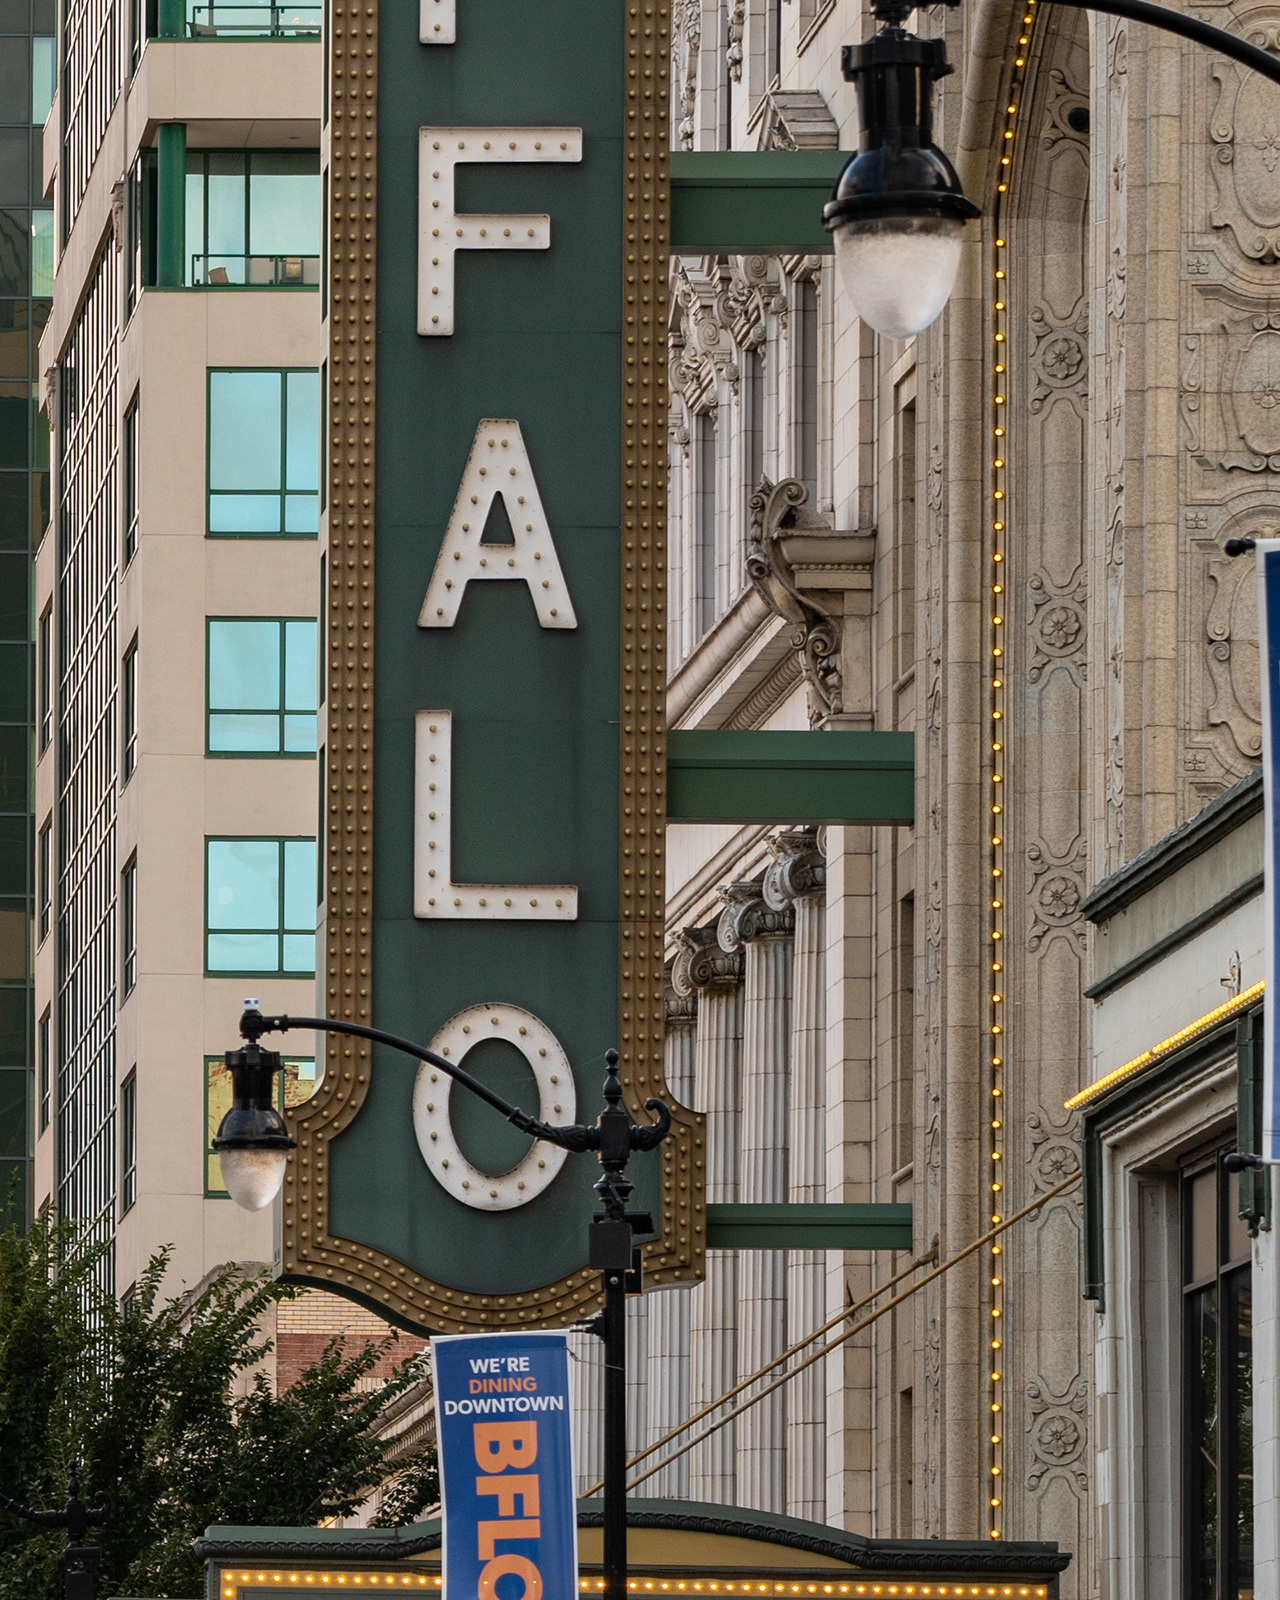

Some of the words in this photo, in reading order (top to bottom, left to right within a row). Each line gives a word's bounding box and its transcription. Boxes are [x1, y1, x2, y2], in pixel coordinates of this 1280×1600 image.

[470, 1357, 530, 1374] WE'RE
[469, 1376, 538, 1394] DINING
[444, 1396, 564, 1416] DOWNTOWN
